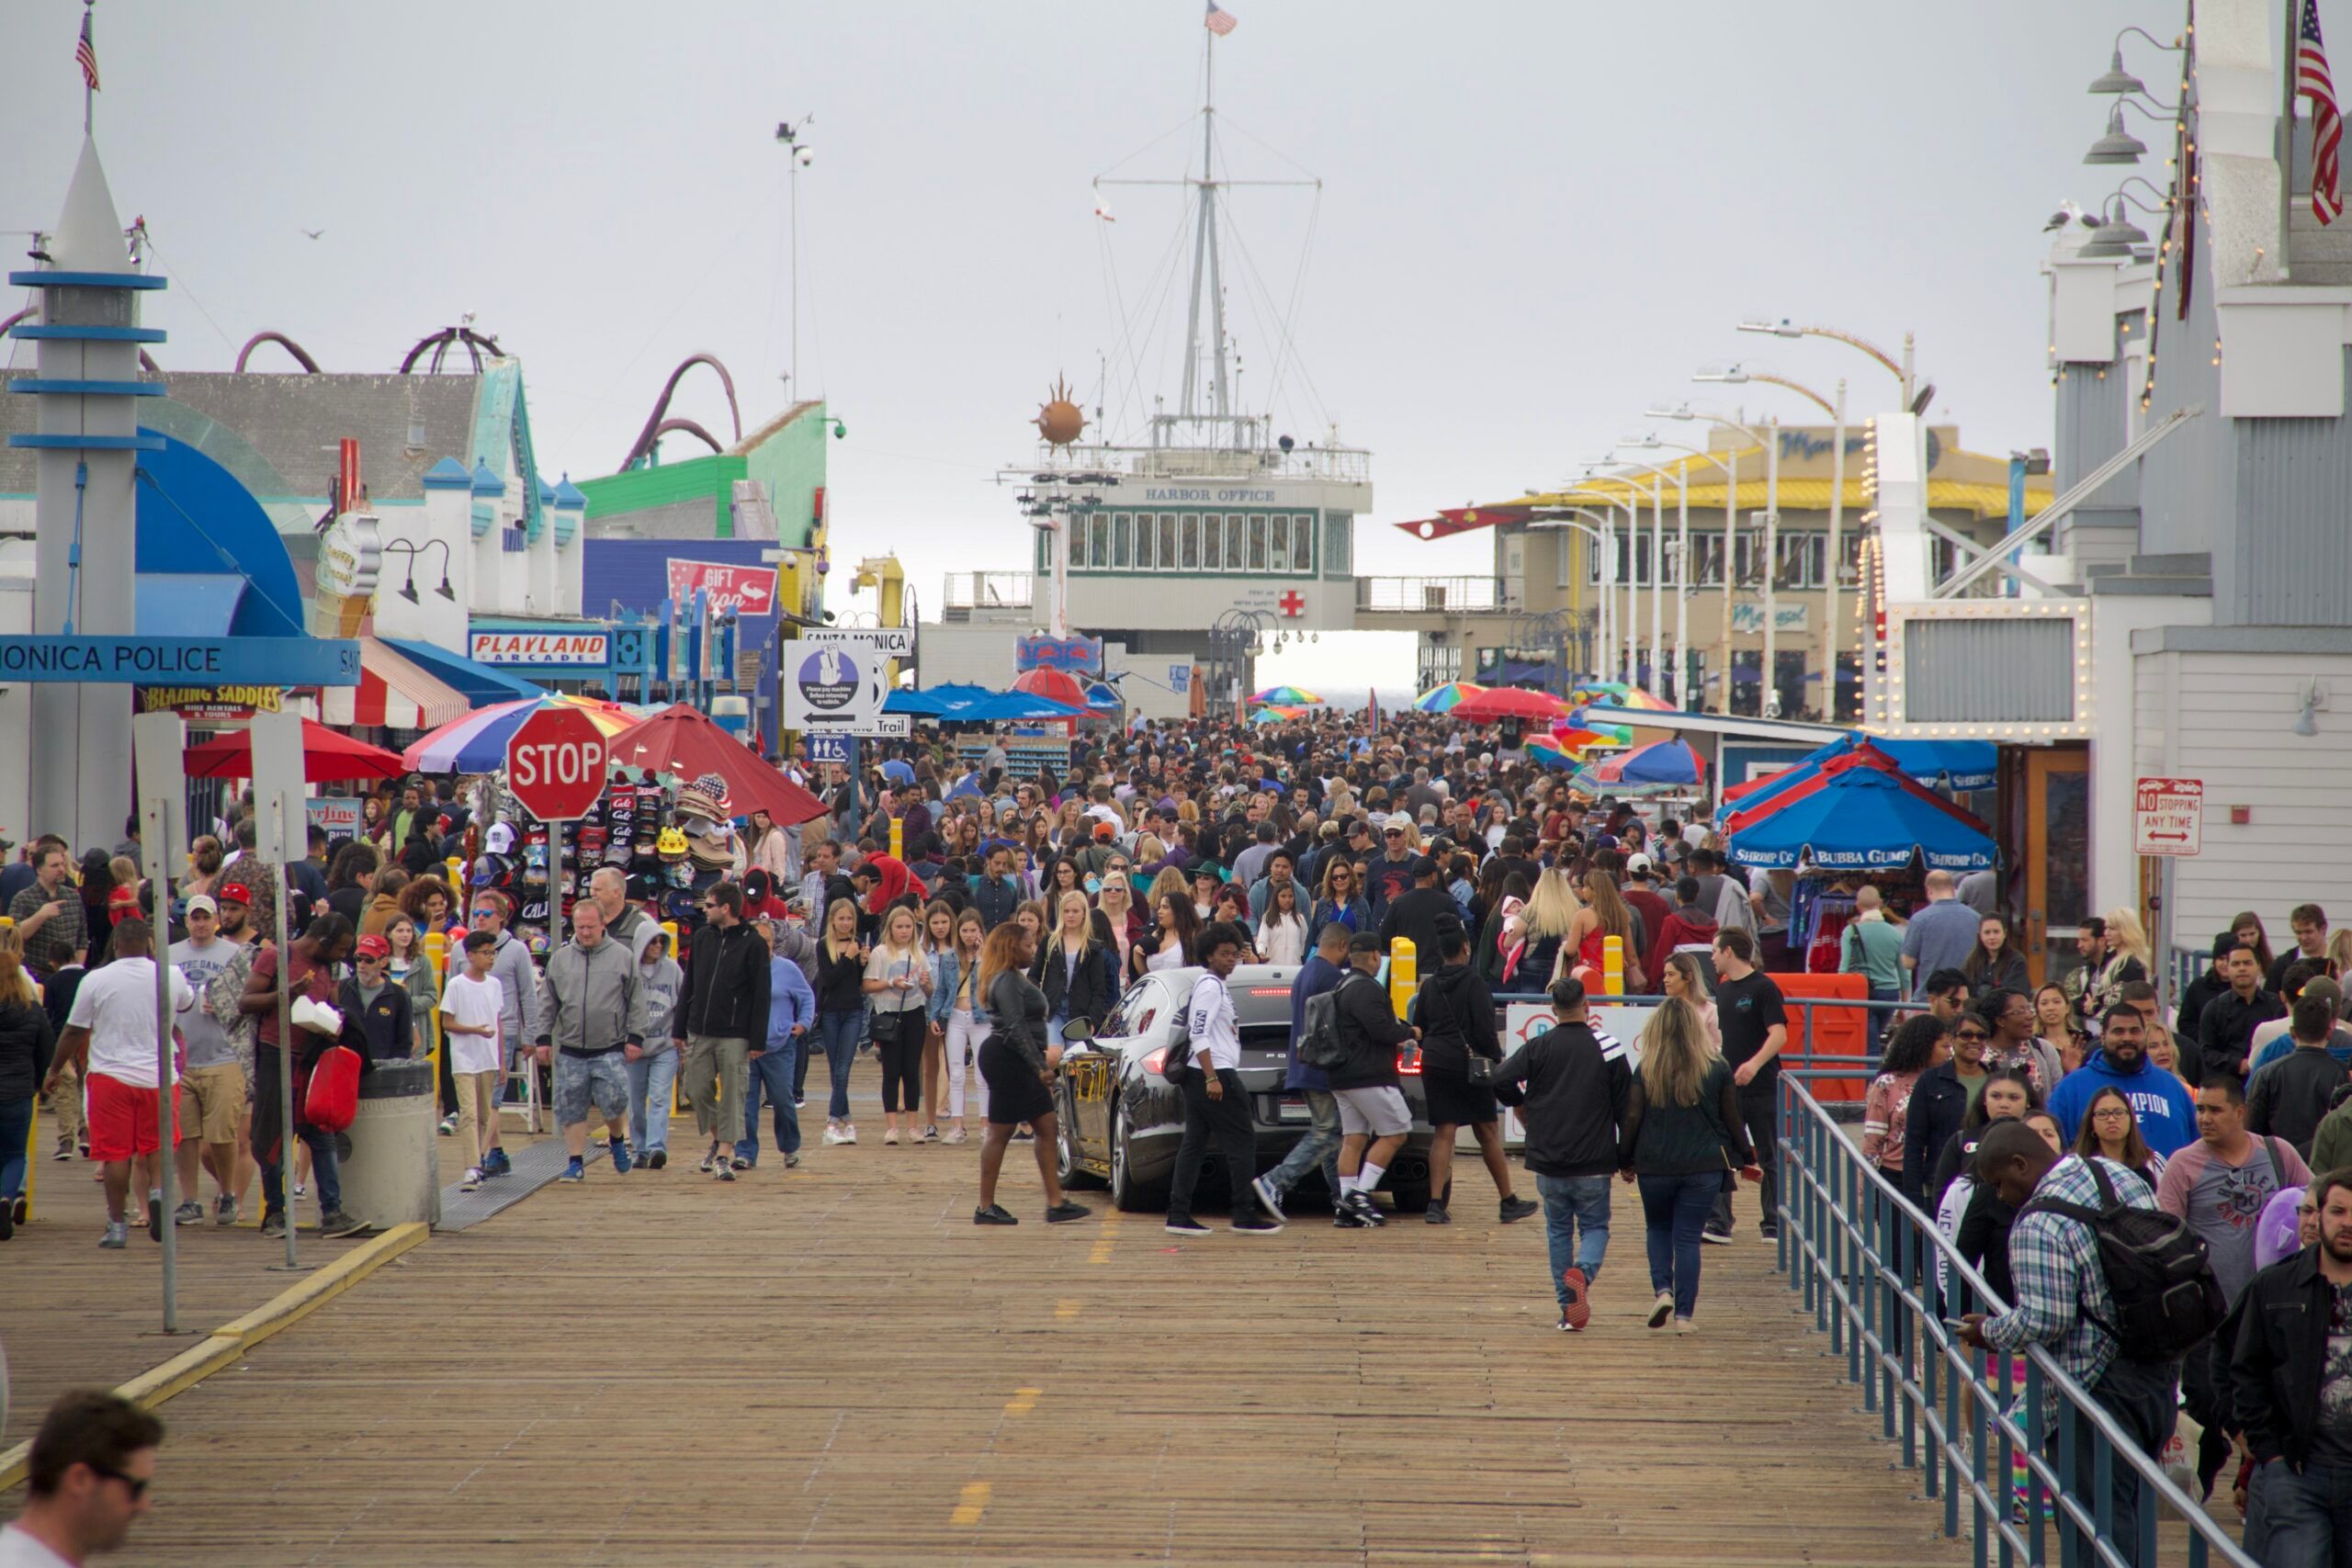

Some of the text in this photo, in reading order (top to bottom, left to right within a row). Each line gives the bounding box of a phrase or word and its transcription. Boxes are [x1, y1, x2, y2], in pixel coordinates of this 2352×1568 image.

[1146, 489, 1275, 502] HARBOR OFFICE
[706, 569, 734, 588] GIFT
[475, 636, 605, 654] PLAYLAND
[0, 645, 221, 672] ONICA POLICE
[494, 654, 585, 662] ARCADE
[146, 685, 281, 714] BLAZING SADDLES
[184, 705, 243, 713] BIKE RENTALS
[204, 711, 232, 719] TOURS
[877, 719, 905, 733] Trail
[514, 741, 602, 787] STOP
[2140, 794, 2199, 811] NO STOPPING
[2144, 816, 2193, 829] ANY TIME
[1736, 848, 1778, 863] SHRIMP
[1817, 850, 1910, 863] BUBBA GUMP
[1928, 852, 1971, 866] SHRIMP
